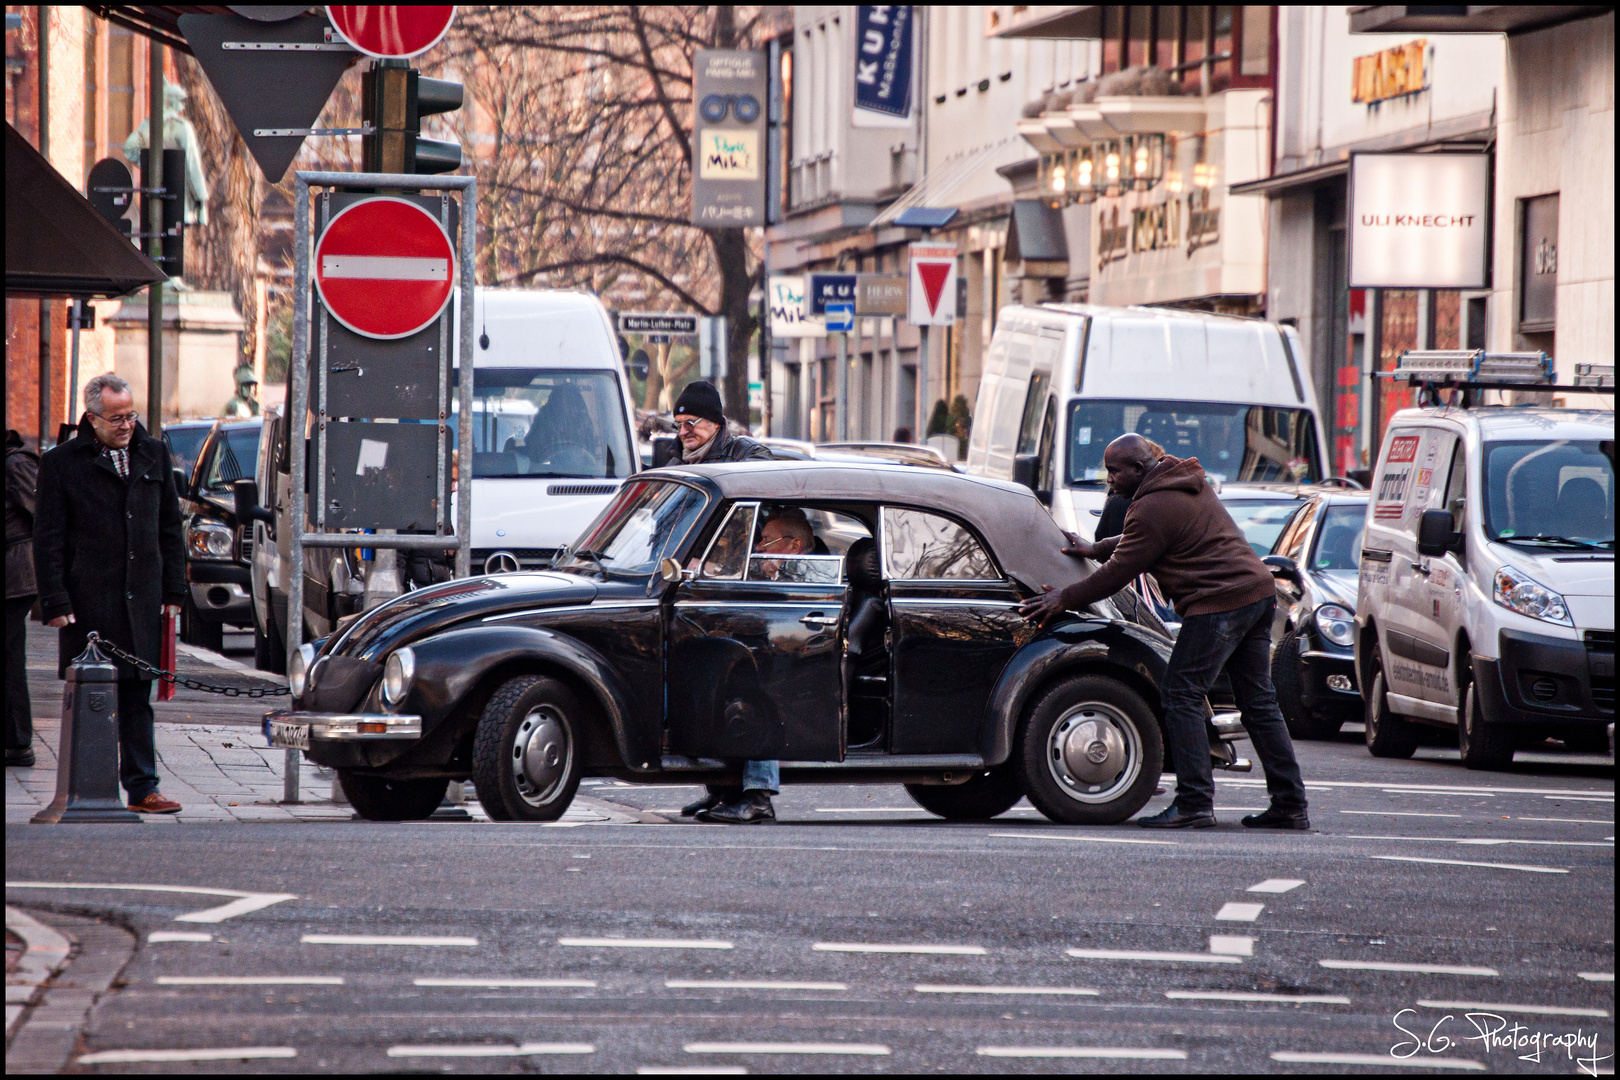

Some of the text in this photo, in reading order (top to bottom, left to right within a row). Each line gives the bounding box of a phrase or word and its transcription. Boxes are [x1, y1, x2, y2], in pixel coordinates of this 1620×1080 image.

[878, 6, 908, 99] Maßkonfe
[1361, 214, 1476, 228] ULI KNECHT
[627, 318, 691, 329] Martin-Luther-Platz
[1389, 440, 1417, 460] ELEKTRO
[1379, 468, 1410, 501] arnold
